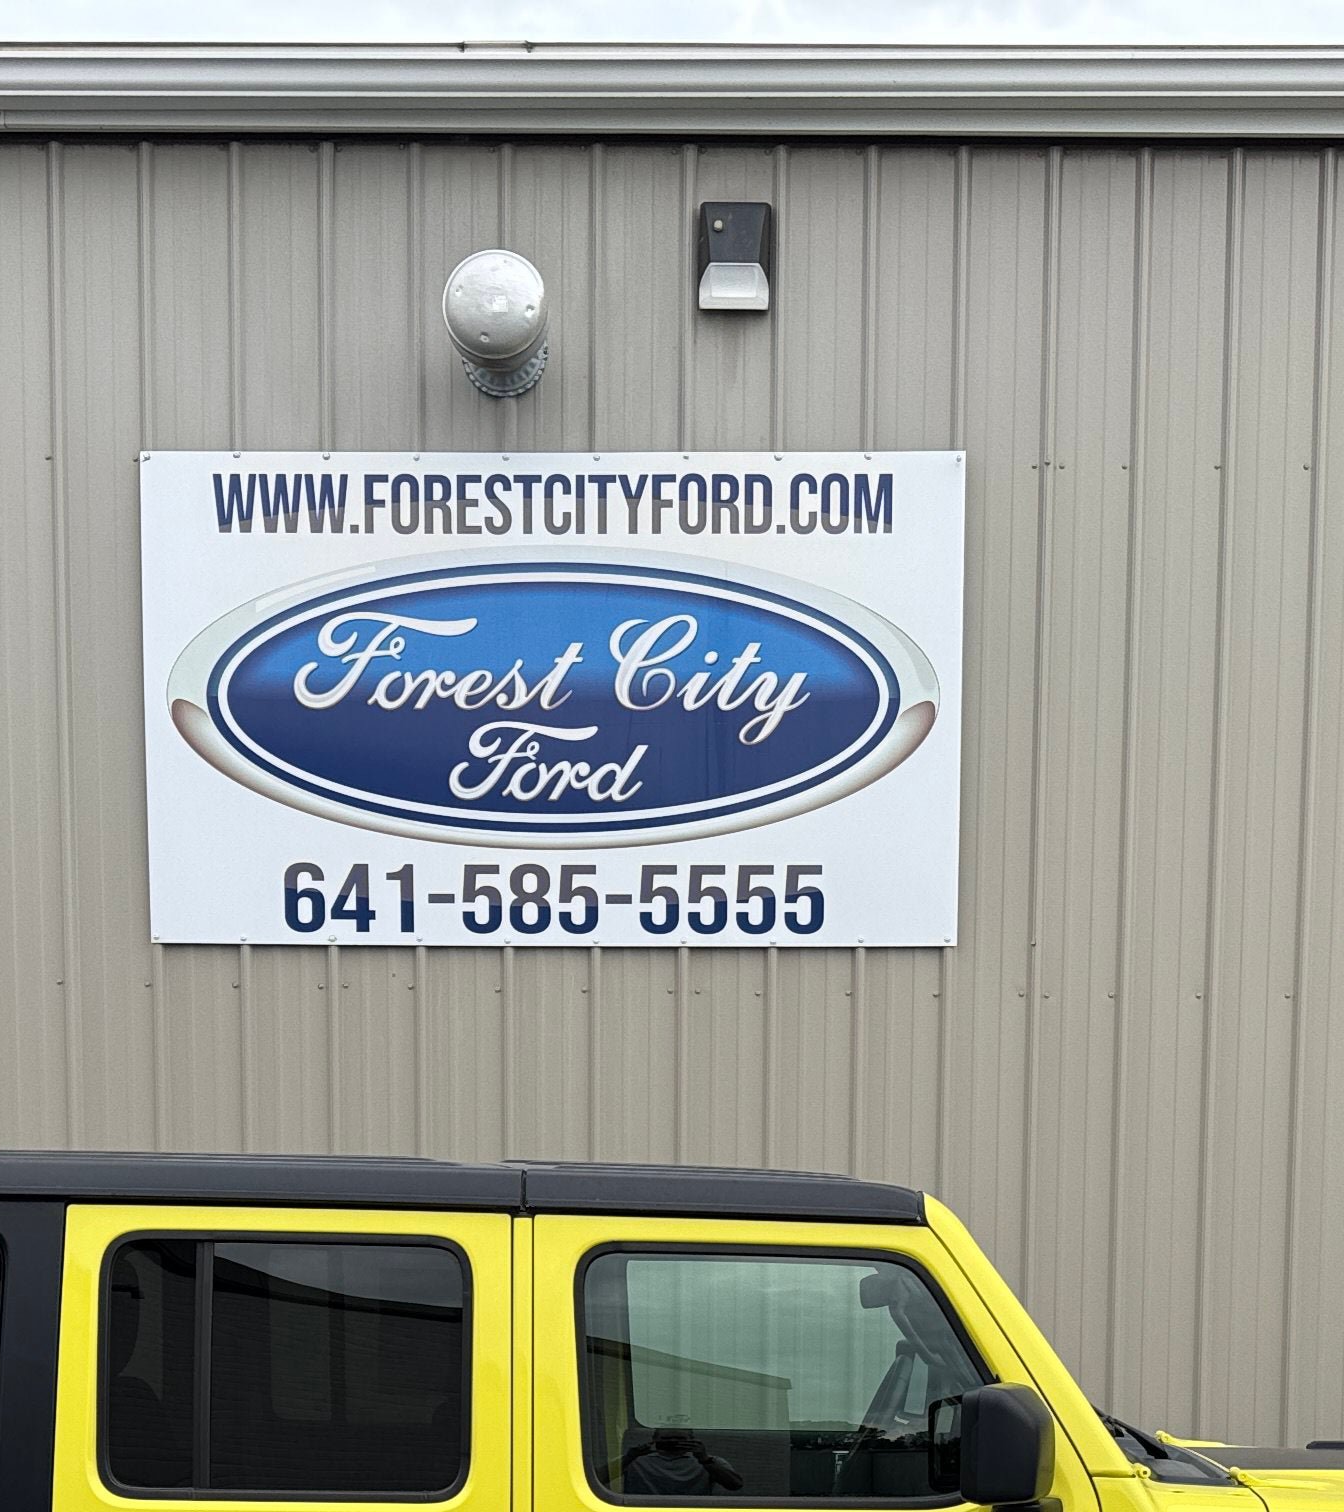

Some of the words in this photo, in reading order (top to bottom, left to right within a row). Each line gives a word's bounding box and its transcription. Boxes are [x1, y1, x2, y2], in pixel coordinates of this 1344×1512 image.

[213, 473, 894, 535] WWW.FORESTCITYFORD.COM
[294, 611, 583, 711] Forest
[609, 613, 812, 746] City
[448, 720, 648, 803] Ford
[283, 862, 825, 935] 641-585-5555
